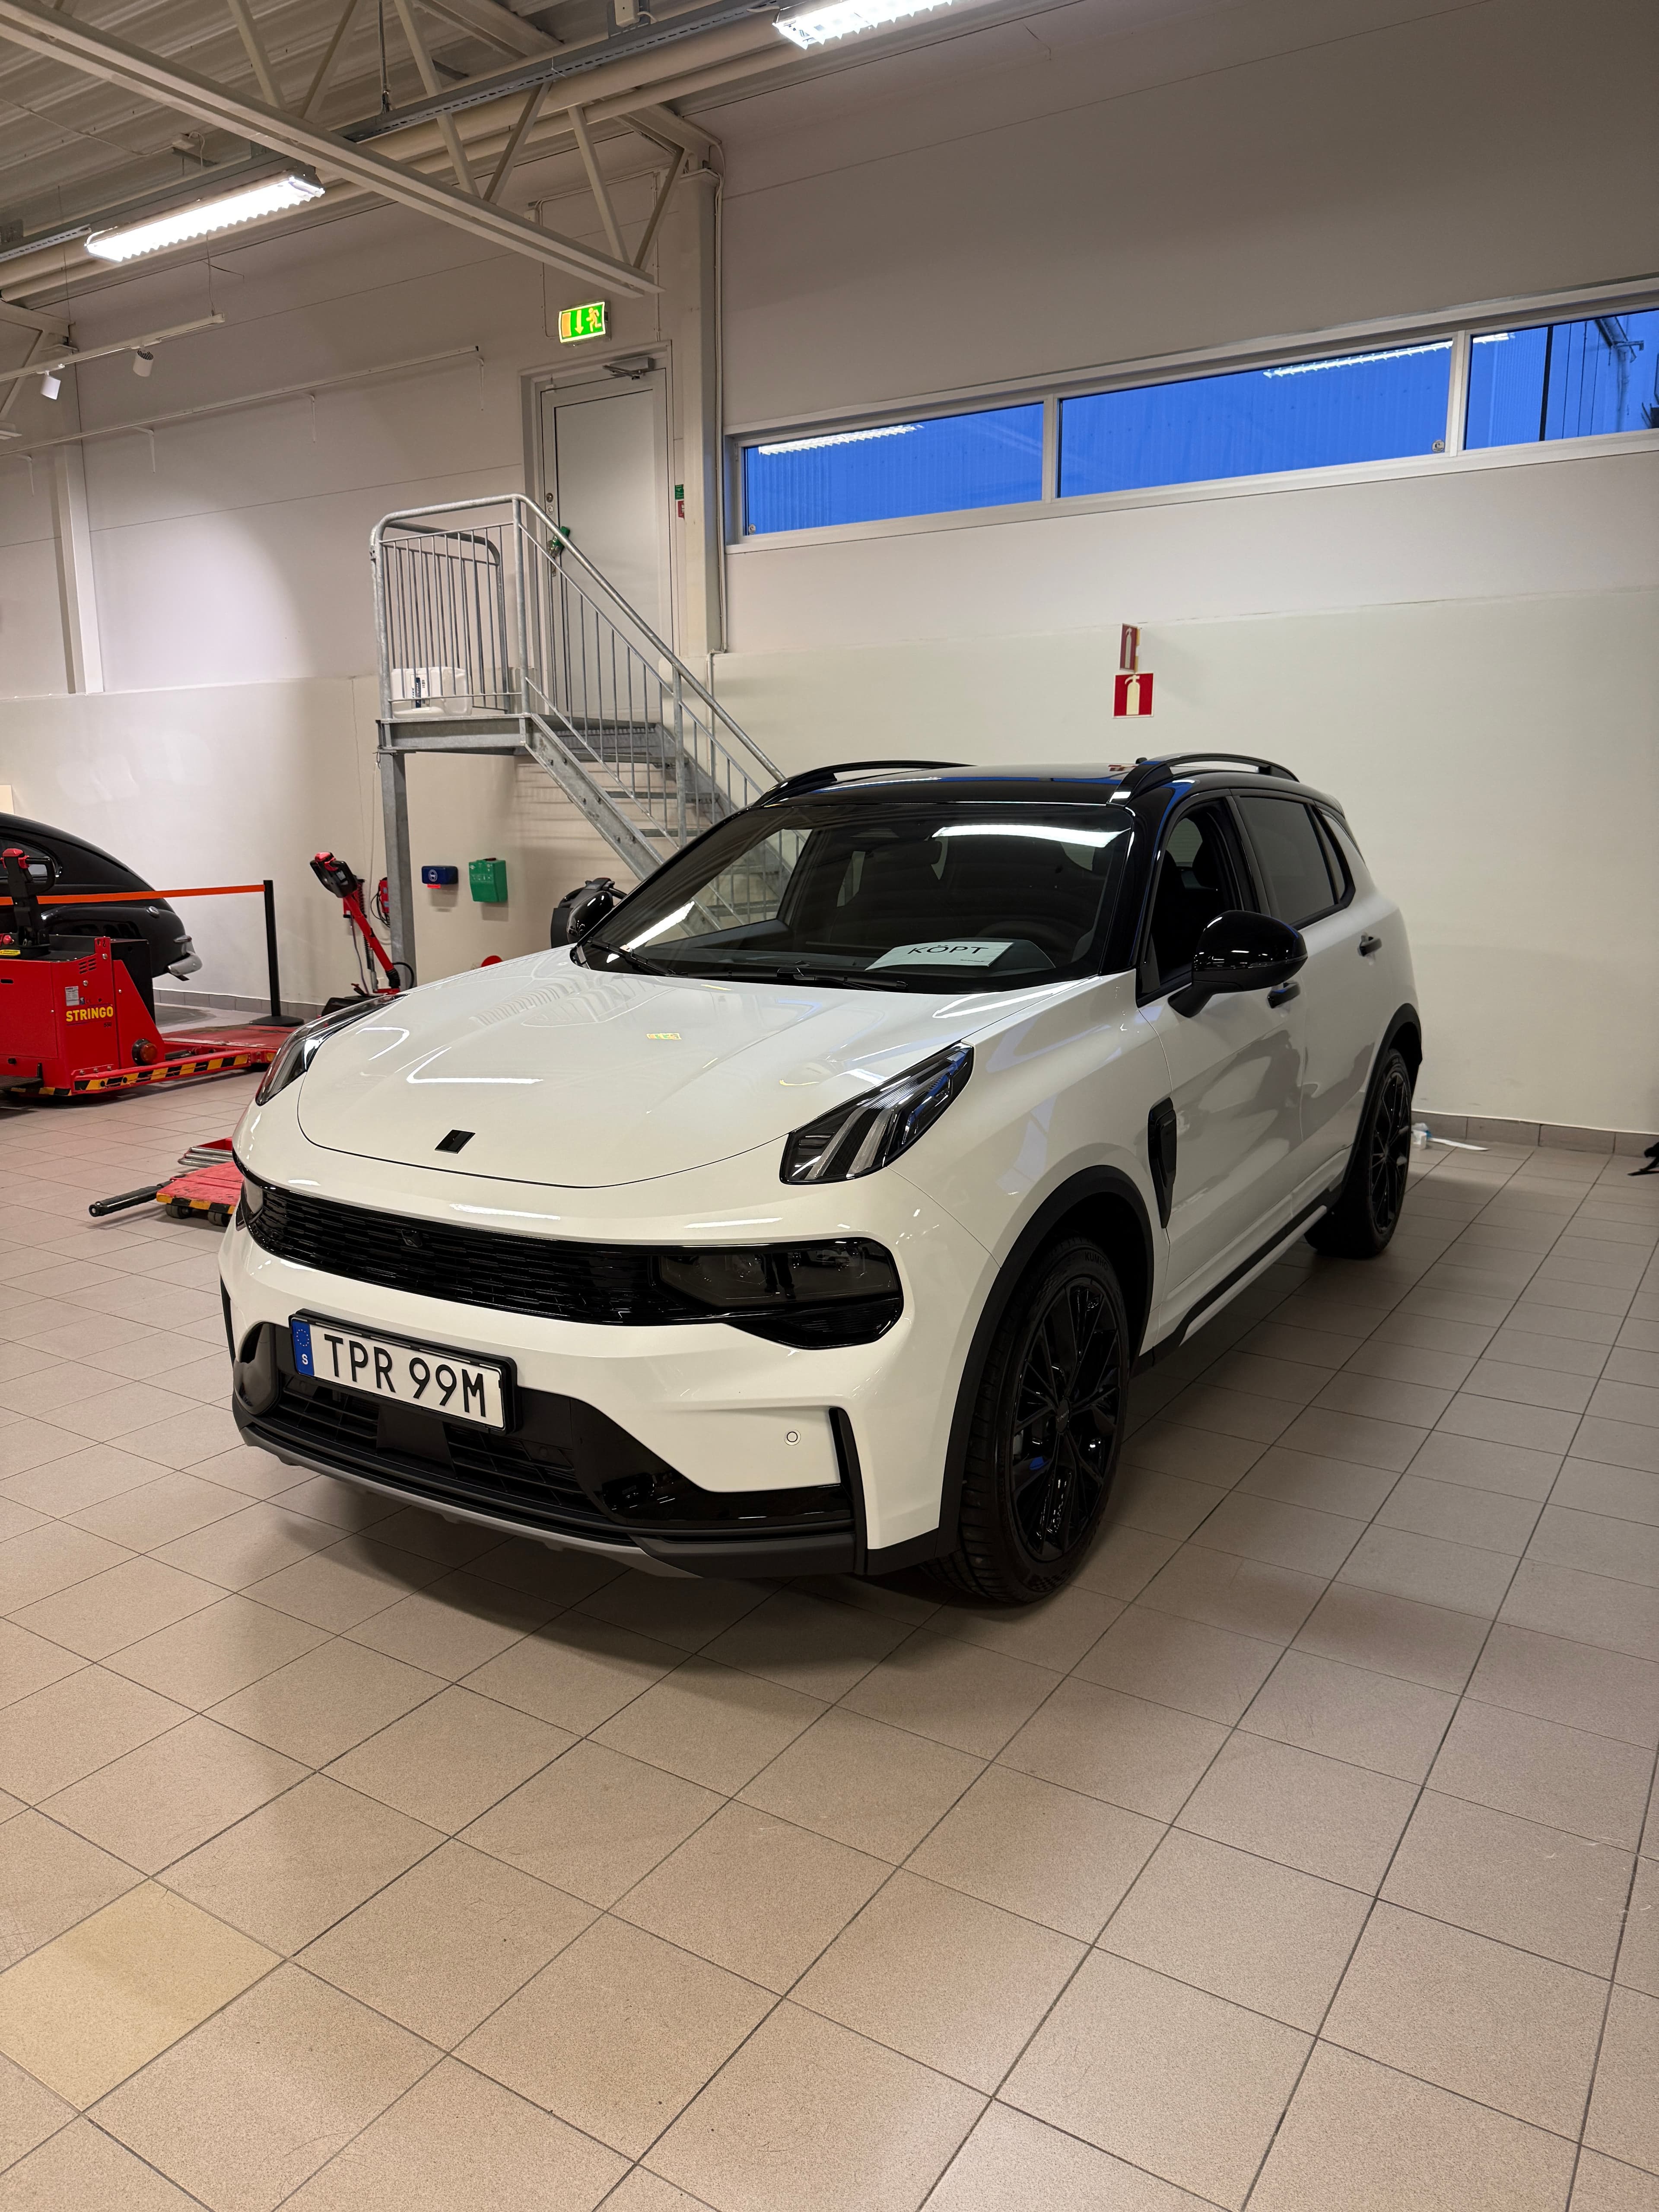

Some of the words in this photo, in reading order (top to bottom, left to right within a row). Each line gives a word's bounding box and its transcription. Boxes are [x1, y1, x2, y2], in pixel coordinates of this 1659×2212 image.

[907, 945, 989, 954] KÖPT
[66, 1006, 113, 1021] STRINGO
[1085, 1252, 1108, 1270] KUMHO
[302, 1354, 308, 1365] S
[324, 1334, 395, 1393] TPR
[409, 1357, 486, 1417] 99M
